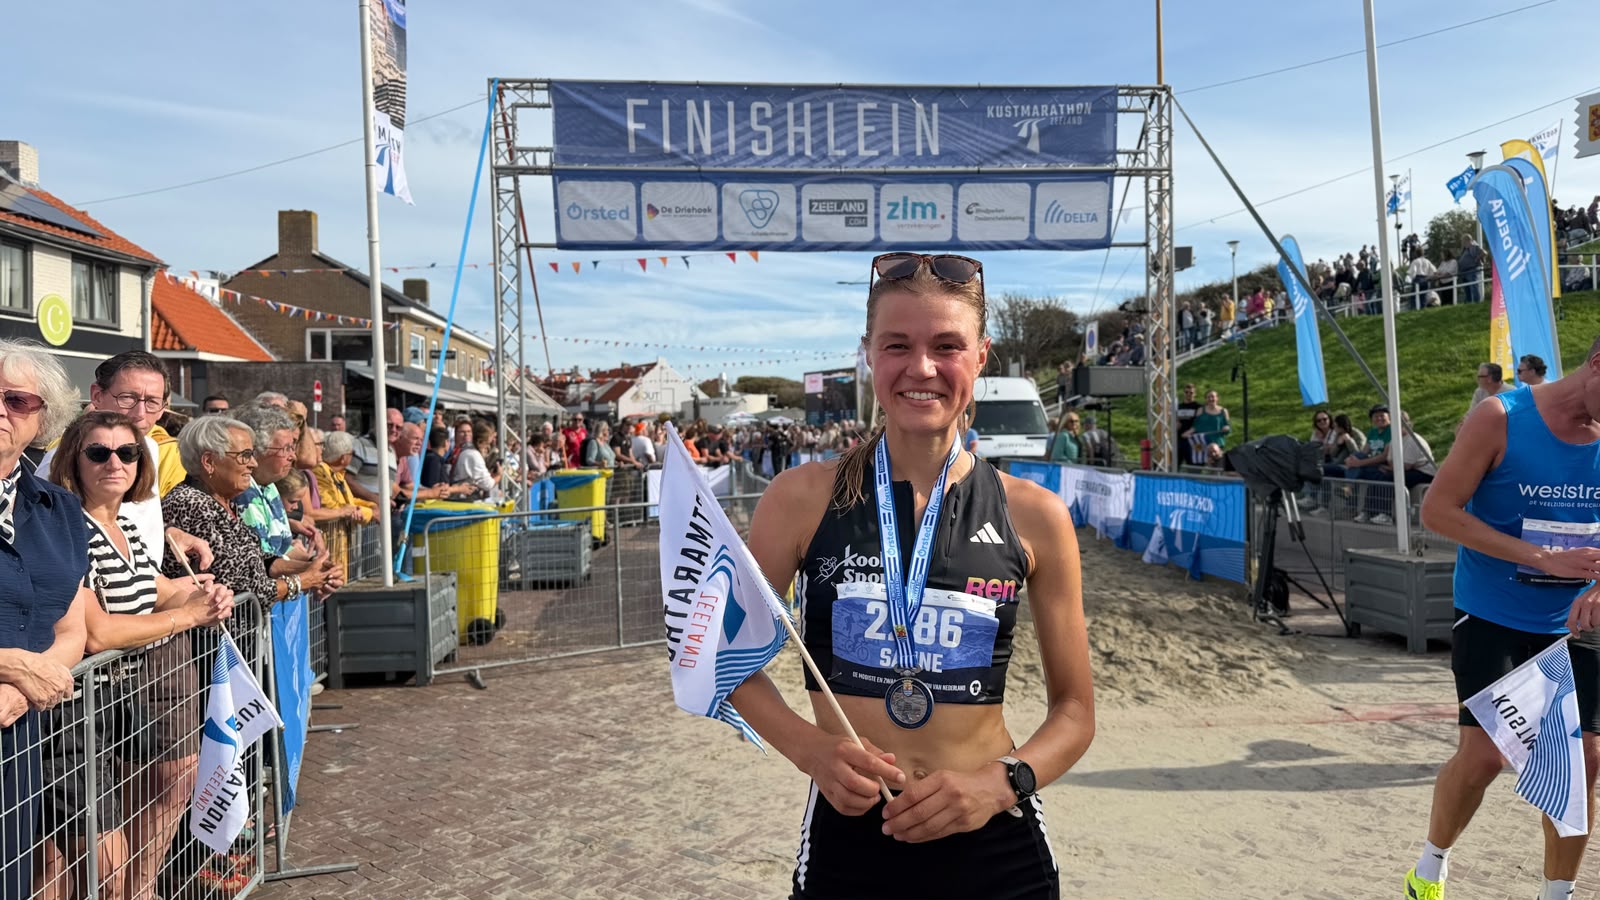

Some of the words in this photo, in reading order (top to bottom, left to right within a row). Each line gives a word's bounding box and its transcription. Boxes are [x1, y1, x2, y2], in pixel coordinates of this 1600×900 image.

[986, 102, 1092, 118] KUSTMARATHON
[626, 98, 940, 156] FINISHLEIN
[1050, 116, 1083, 126] ZEELAND
[566, 202, 630, 221] Ørsted
[661, 206, 673, 214] De
[674, 205, 713, 214] Driehoek
[811, 201, 865, 212] ZEELAND
[1063, 213, 1098, 224] DELTA
[1518, 483, 1600, 500] weststra
[965, 576, 1016, 602] Ren
[864, 600, 964, 648] 286
[195, 764, 229, 812] ZEELAND
